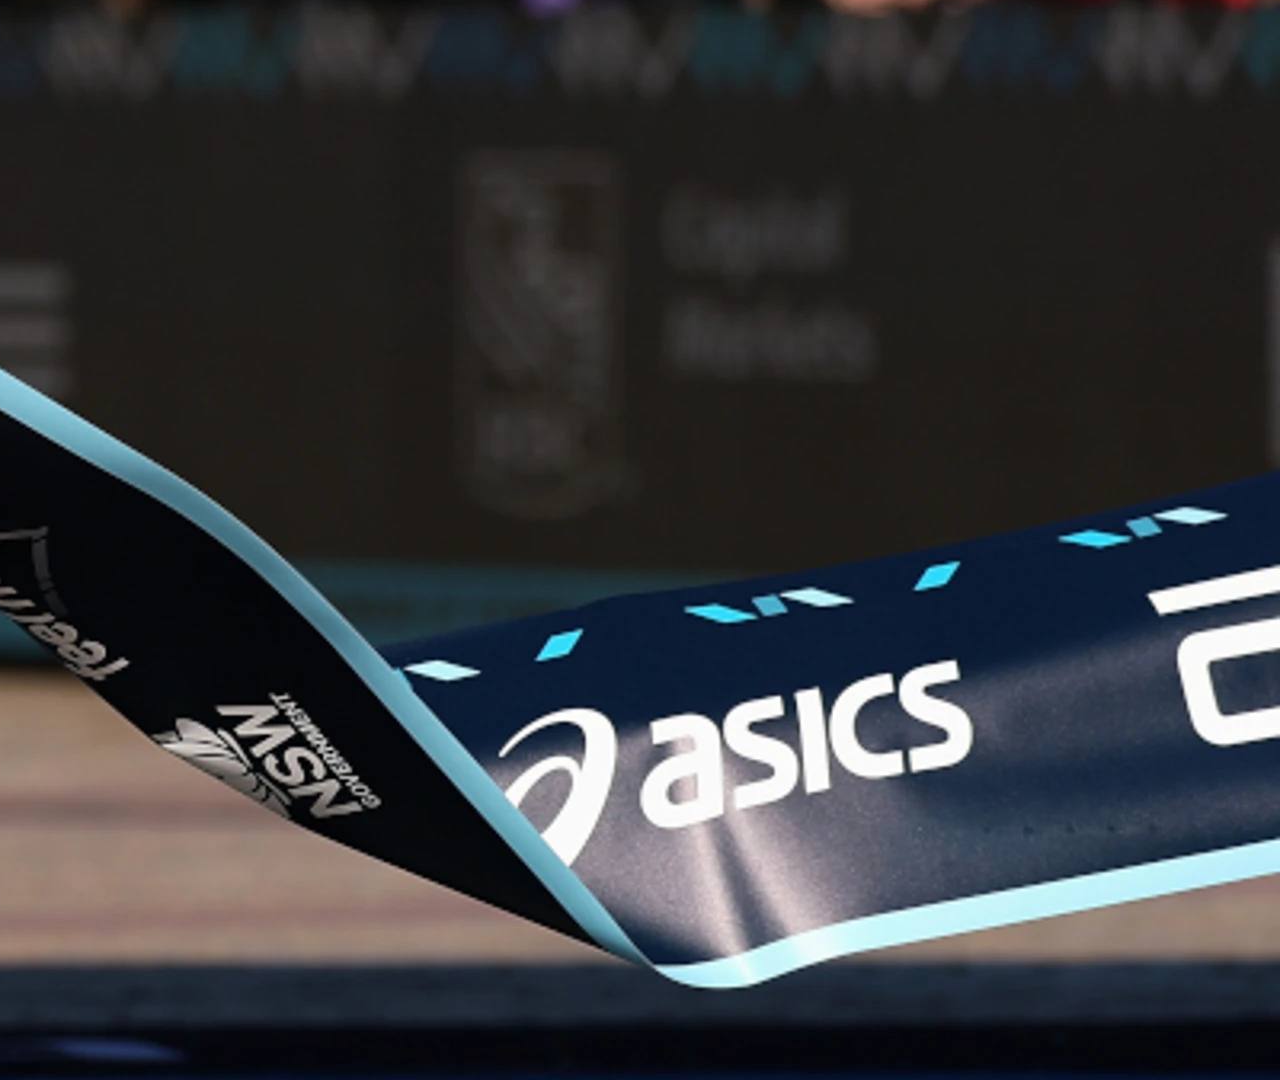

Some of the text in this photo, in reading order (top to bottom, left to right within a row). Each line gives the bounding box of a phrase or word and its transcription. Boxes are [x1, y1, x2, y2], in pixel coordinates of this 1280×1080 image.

[215, 705, 363, 818] NSW
[269, 692, 382, 809] GOVERNMENT
[639, 659, 974, 830] asics
